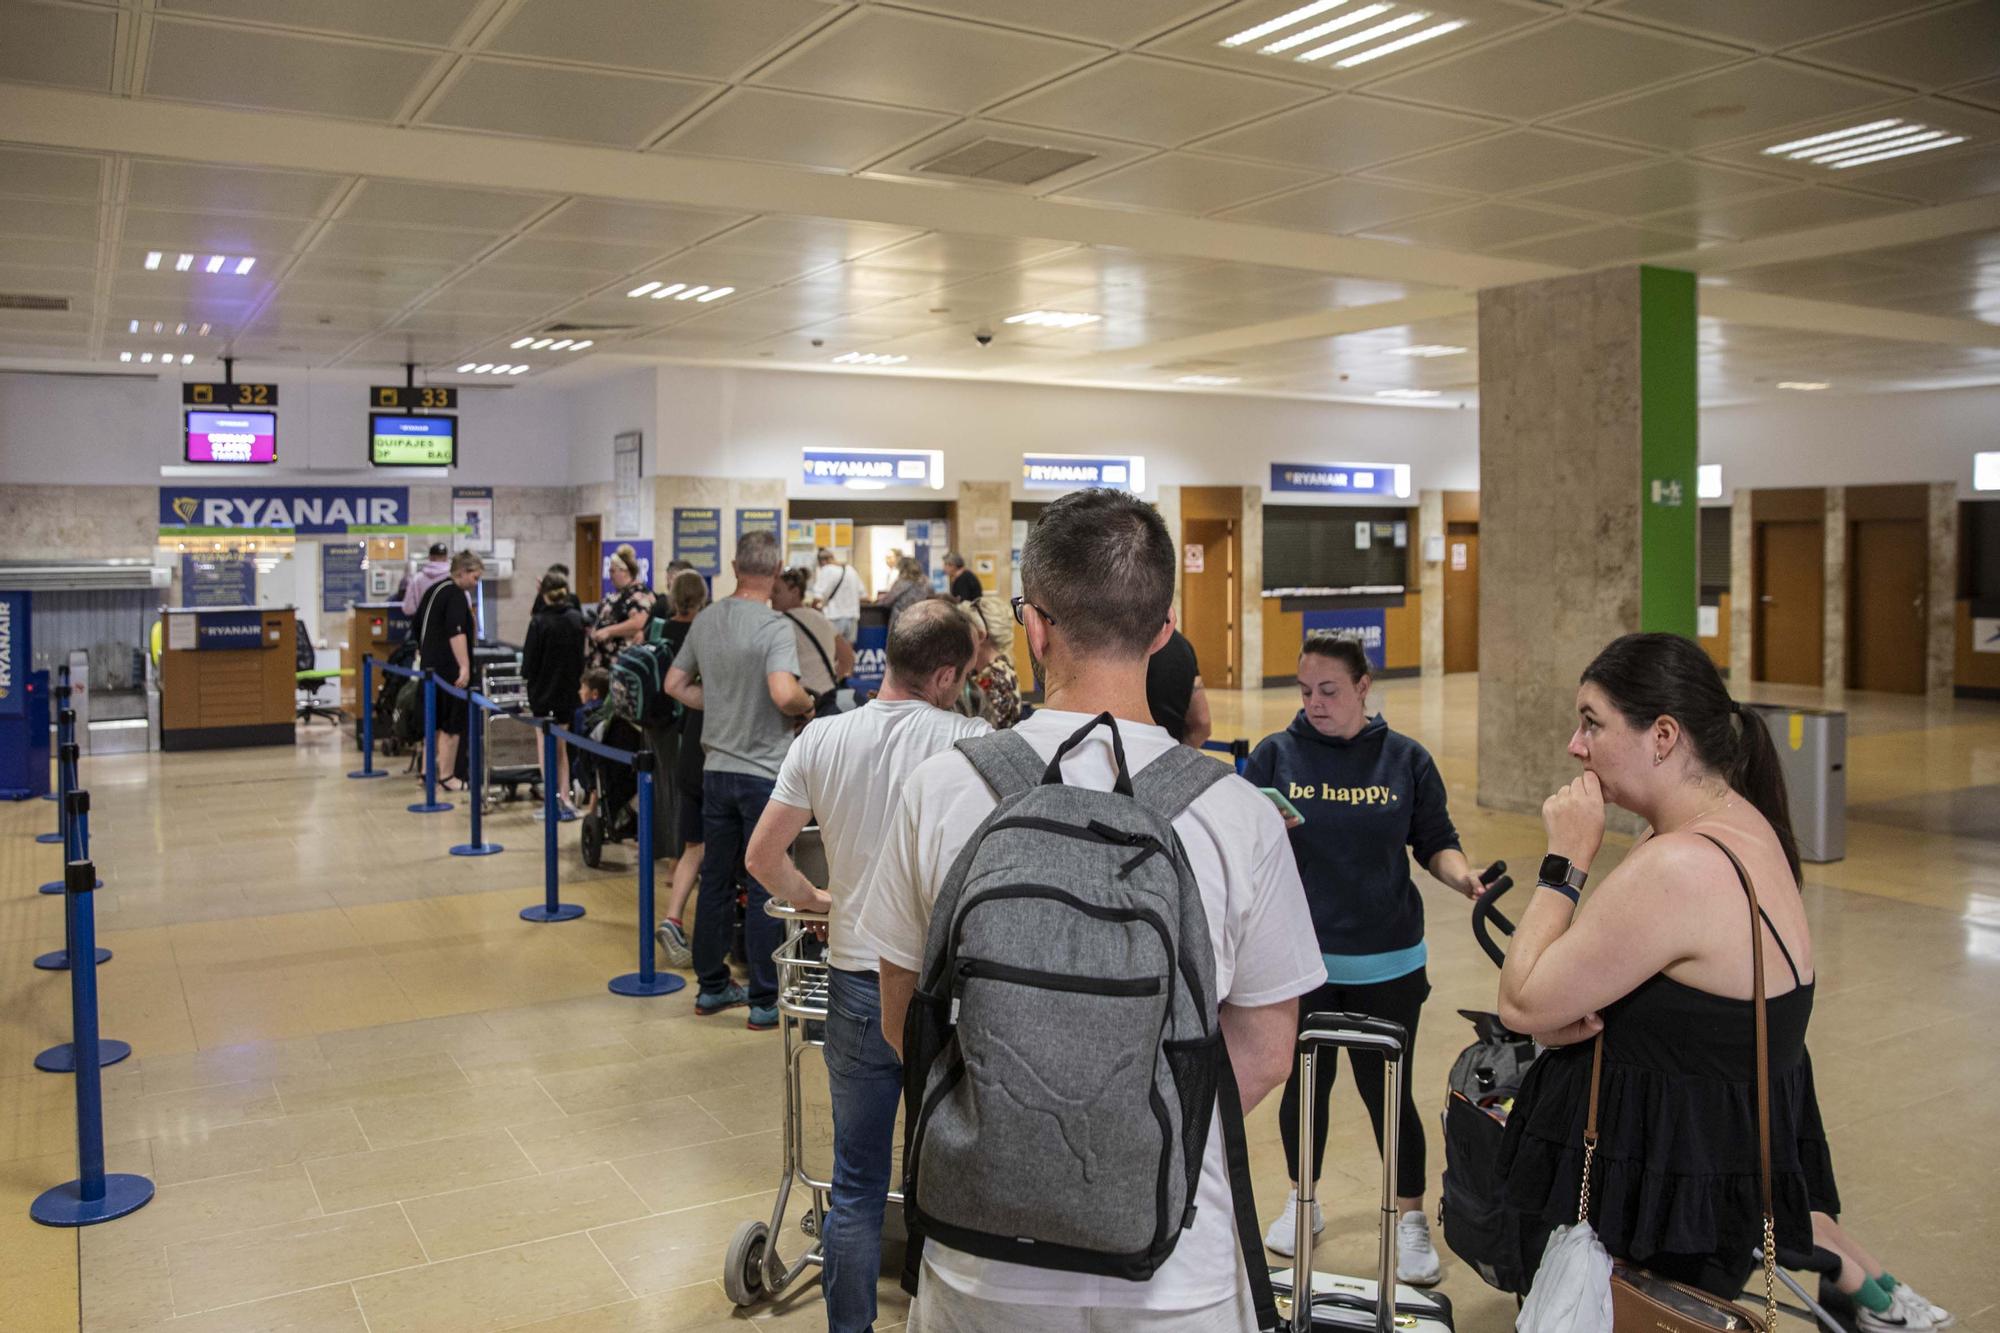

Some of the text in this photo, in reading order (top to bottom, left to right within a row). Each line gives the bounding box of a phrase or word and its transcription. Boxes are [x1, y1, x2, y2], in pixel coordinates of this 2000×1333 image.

[240, 384, 269, 405] 32
[421, 388, 449, 407] 33
[1291, 472, 1349, 487] RYANAIR
[203, 497, 400, 527] RYANAIR
[207, 624, 262, 637] RYANAIR
[1289, 782, 1398, 806] be happy.
